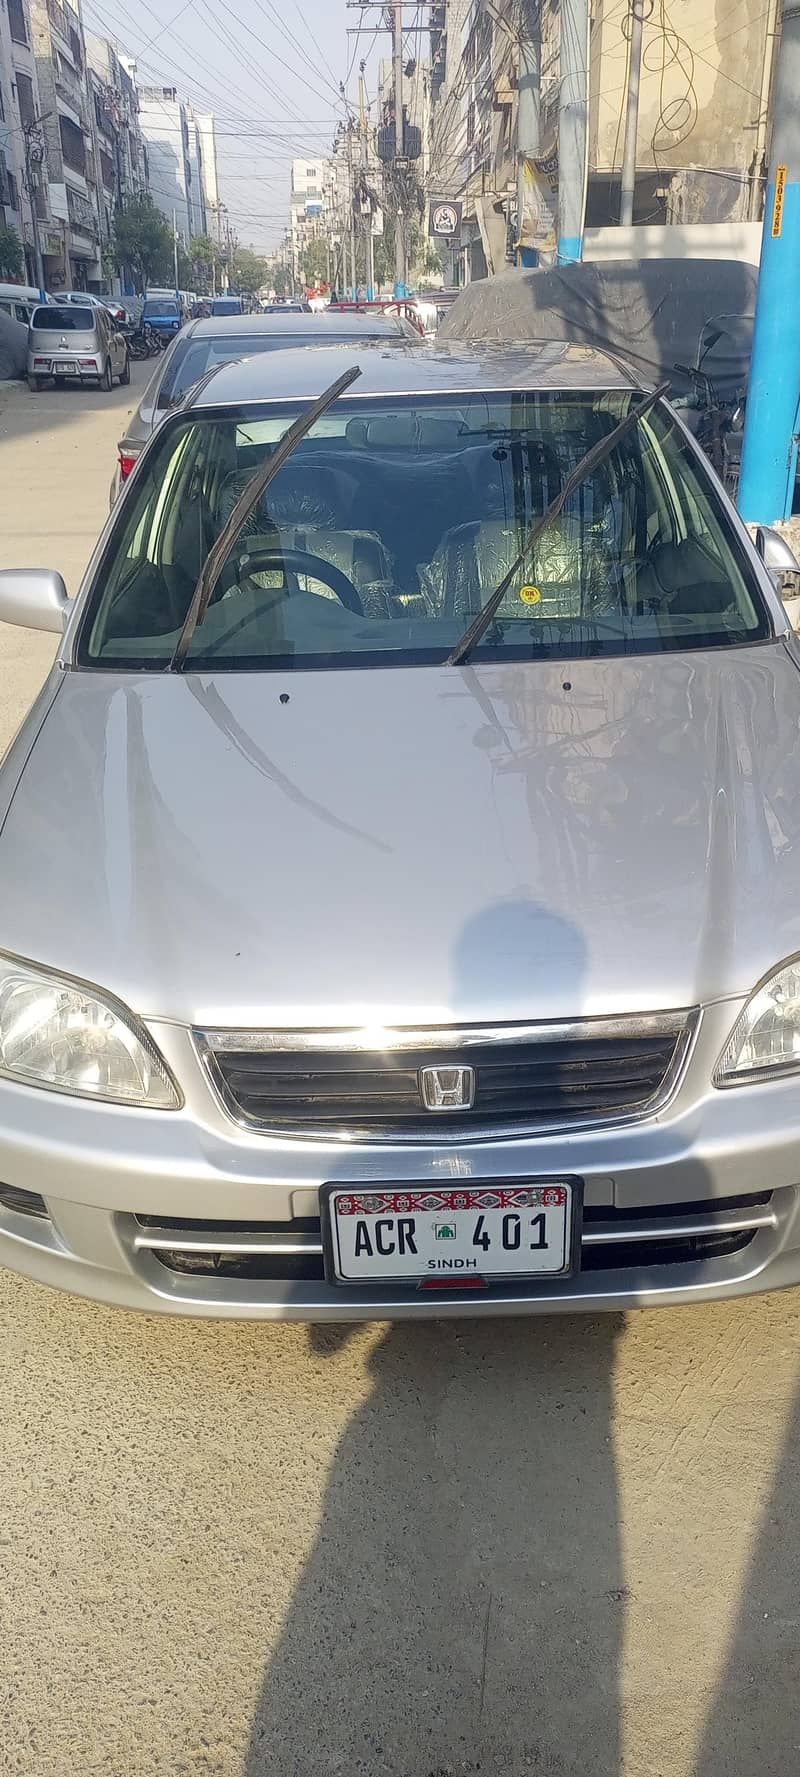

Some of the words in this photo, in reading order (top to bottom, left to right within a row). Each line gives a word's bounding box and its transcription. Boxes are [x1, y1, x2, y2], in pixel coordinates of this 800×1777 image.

[355, 1218, 418, 1257] ACR
[472, 1213, 549, 1251] 401
[427, 1258, 477, 1269] SINDH
